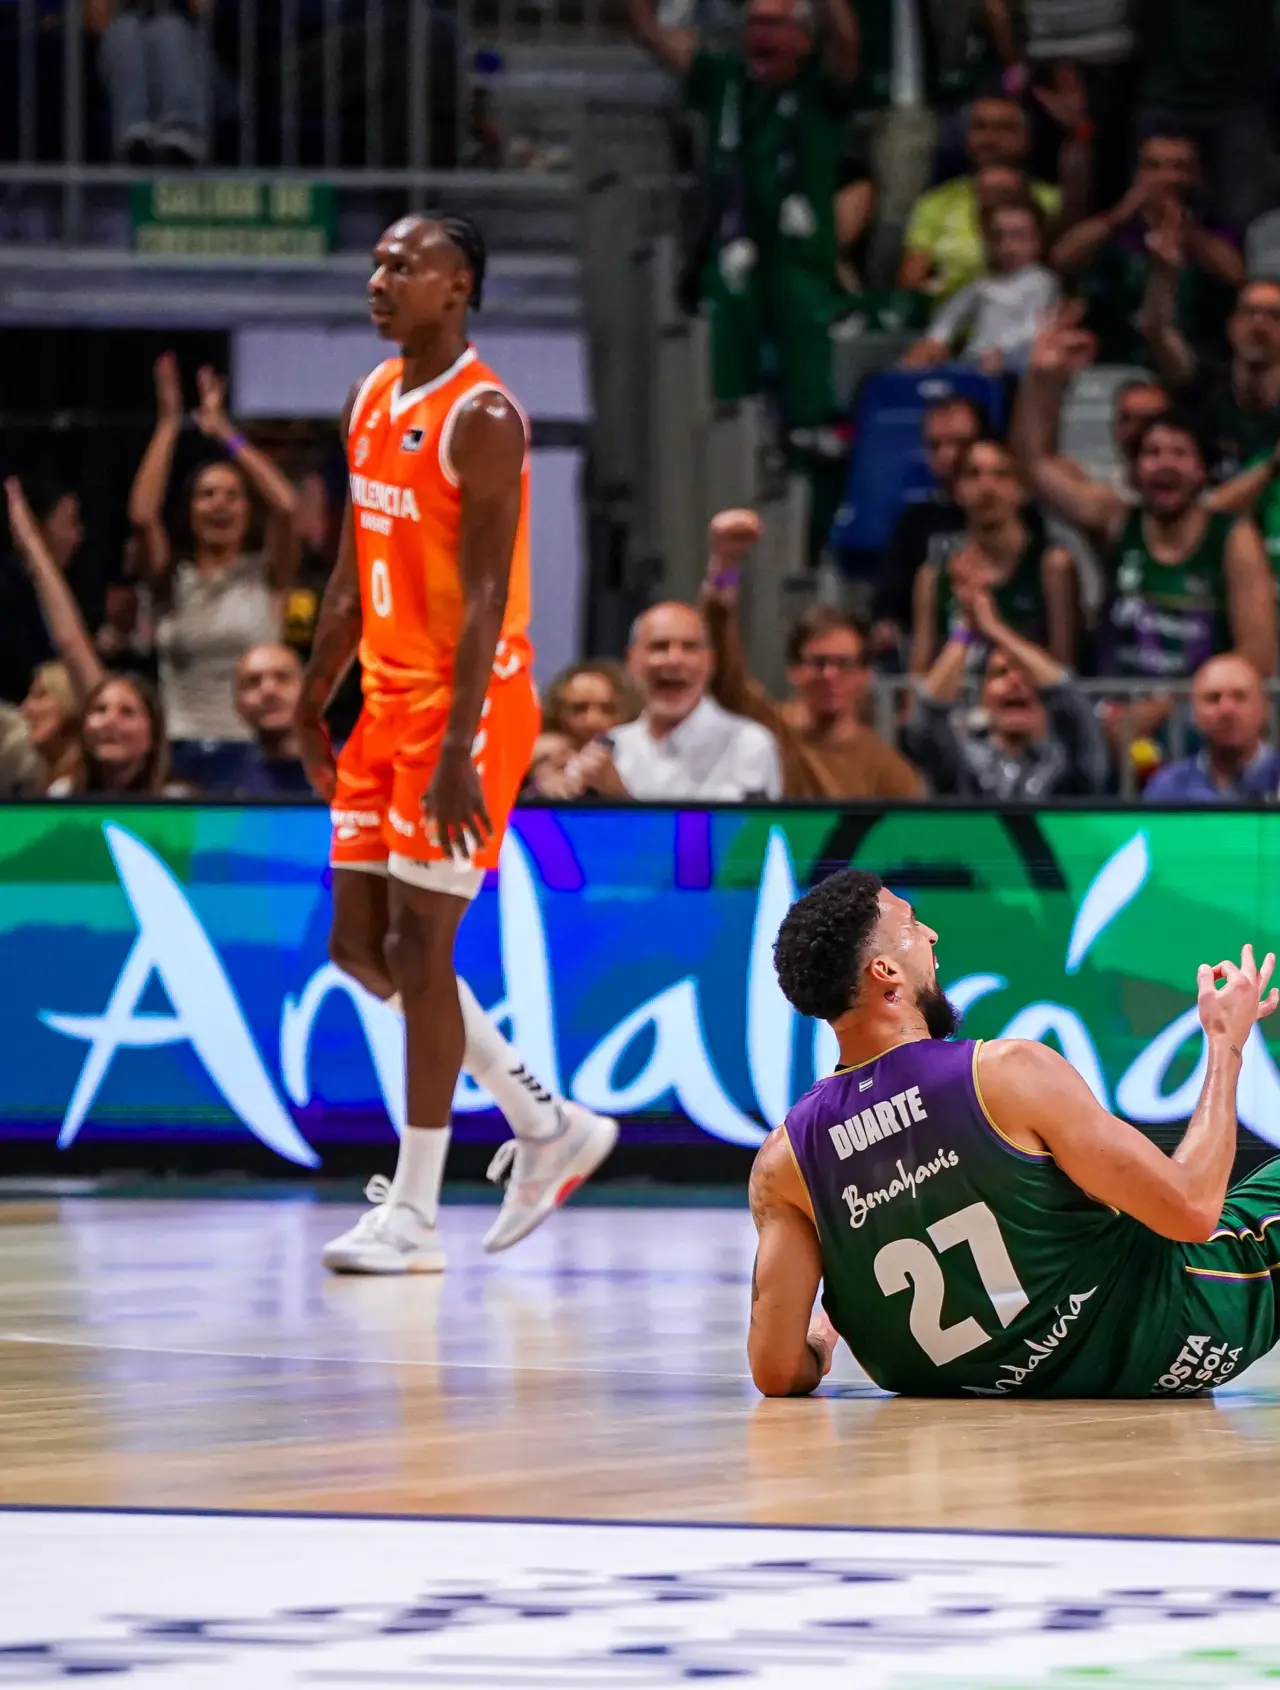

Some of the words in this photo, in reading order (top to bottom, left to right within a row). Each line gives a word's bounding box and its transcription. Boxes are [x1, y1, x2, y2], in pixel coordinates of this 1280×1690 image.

[371, 559, 392, 618] 0
[828, 1085, 928, 1161] DUARTE
[874, 1201, 1030, 1367] 27
[1152, 1335, 1211, 1393] OSTA
[1195, 1342, 1228, 1381] SOL
